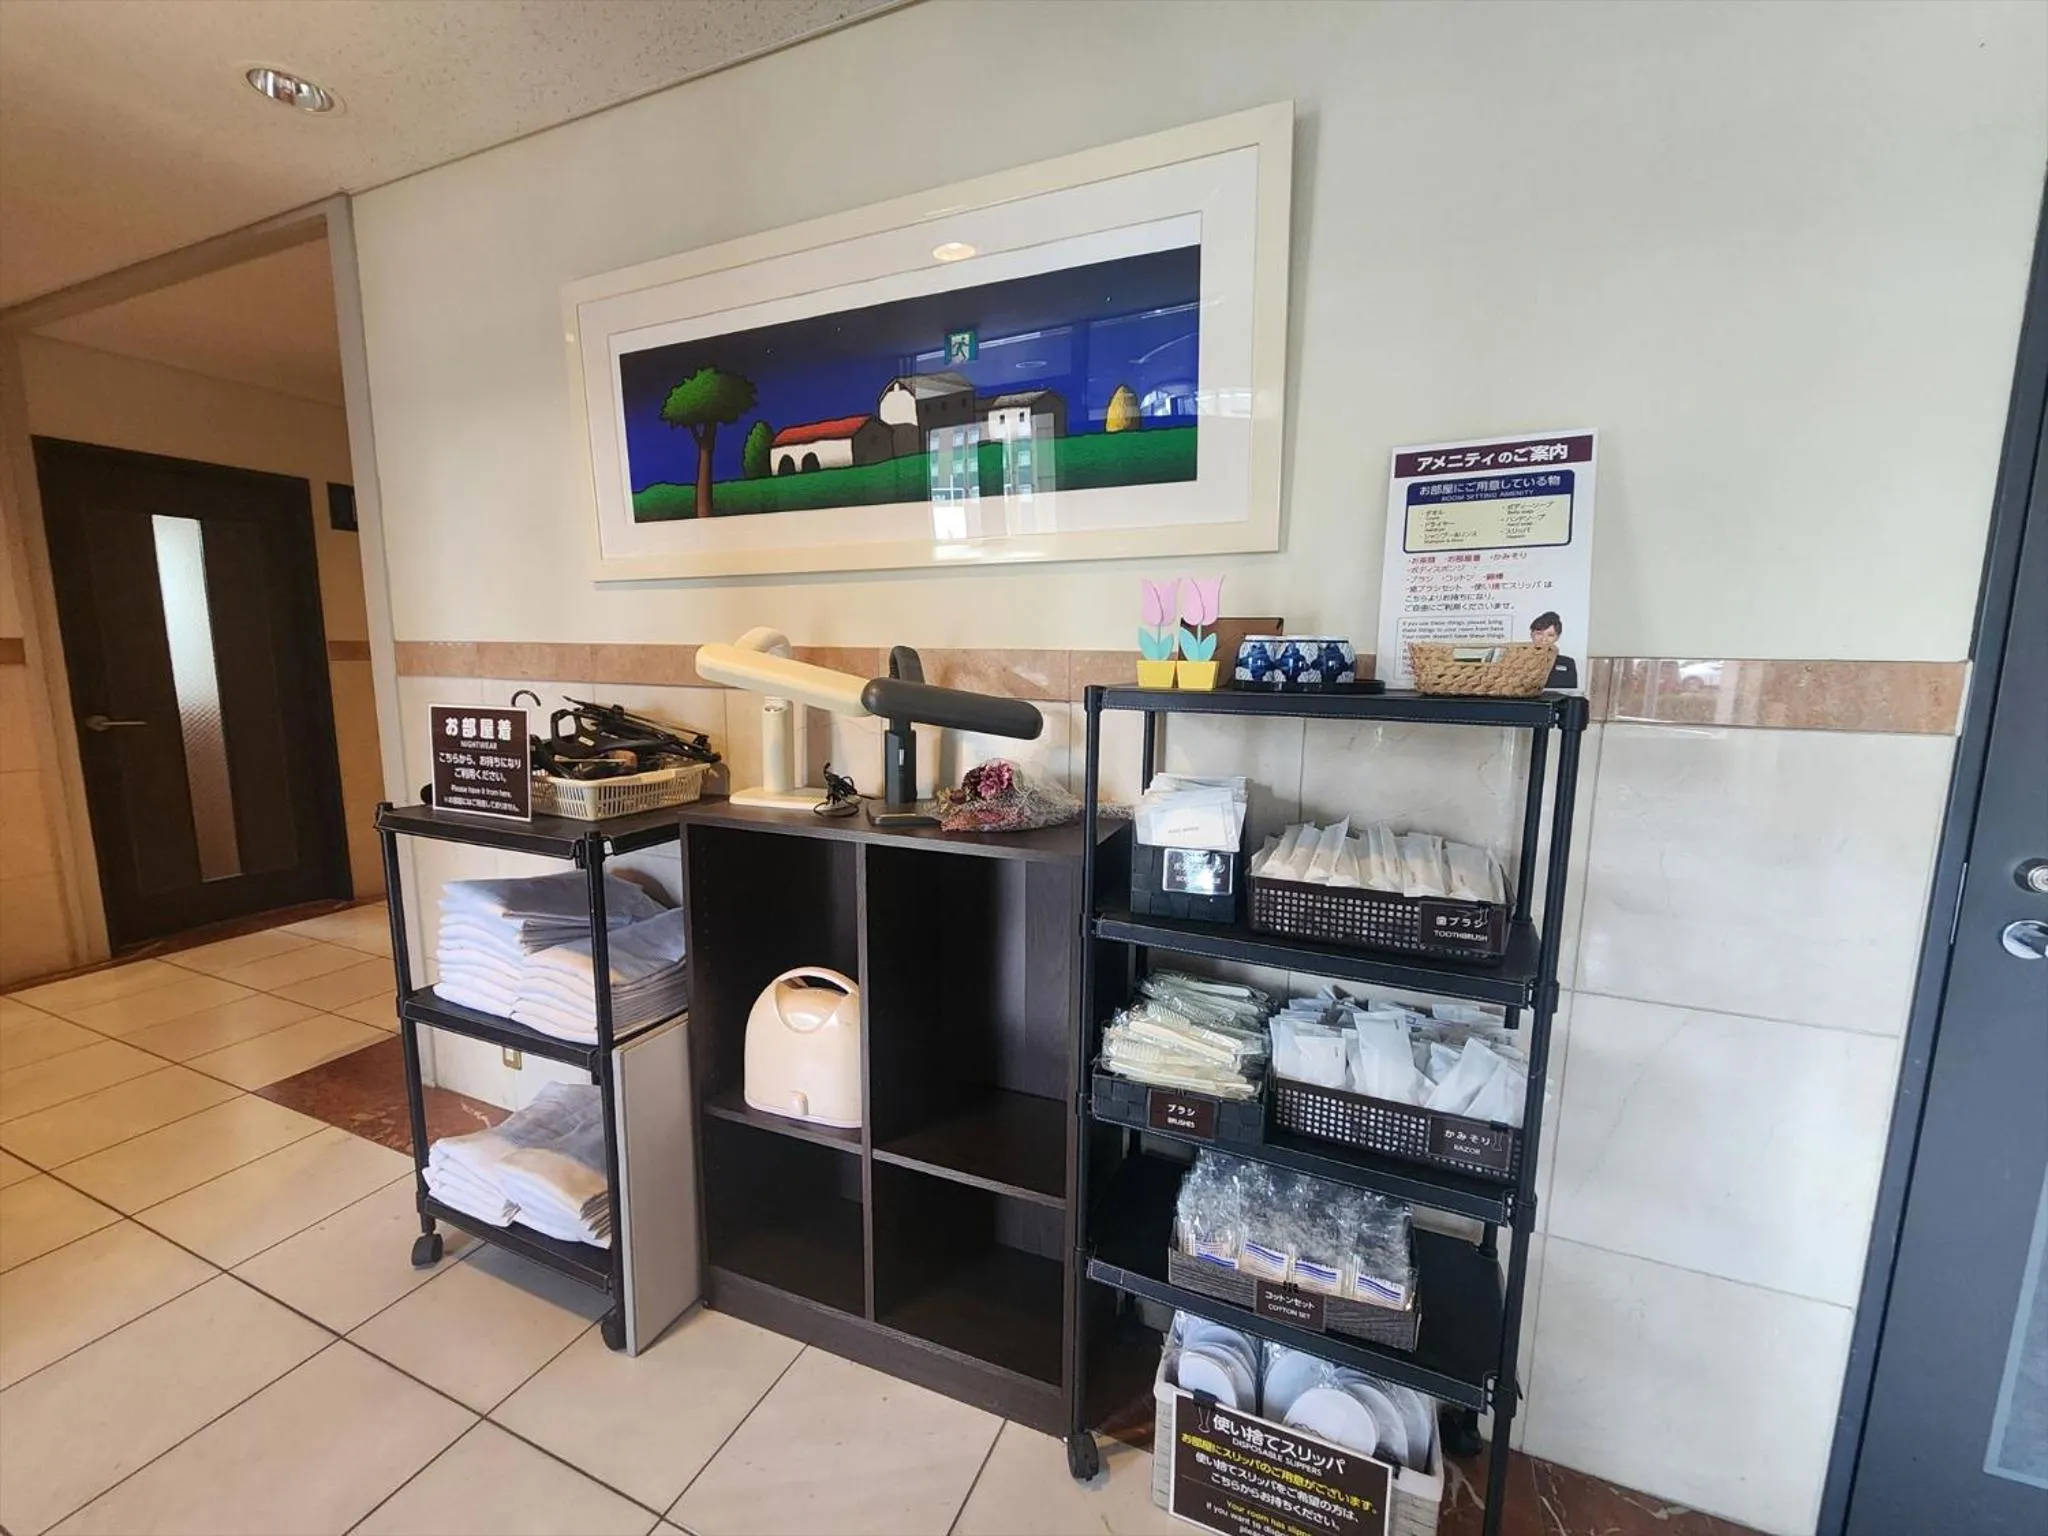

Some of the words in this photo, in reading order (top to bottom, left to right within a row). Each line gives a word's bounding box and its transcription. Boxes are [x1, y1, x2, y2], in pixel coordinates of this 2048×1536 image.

[1417, 443, 1569, 472] アメニティのご案内
[1419, 475, 1561, 497] お部屋にご用意している物
[445, 717, 512, 741] お部屋着
[1435, 915, 1484, 929] 歯ブラシ
[1433, 929, 1488, 942] TOOTHBRUSH
[1167, 1103, 1196, 1117] ブラシ
[1444, 1129, 1491, 1146] かみそり
[1453, 1143, 1481, 1155] RAZOR
[1264, 1290, 1316, 1310] コットンセット
[1267, 1303, 1298, 1317] COTTON
[1213, 1413, 1346, 1475] 使い捨てスリッパ
[1232, 1436, 1284, 1464] DISPOSABLE
[1285, 1456, 1323, 1477] SLIPPERS
[1180, 1432, 1378, 1515] お部屋にスリッパのご用意がございます。
[1195, 1450, 1359, 1523] 使い捨てスリッパをご希望の方は、
[1210, 1472, 1341, 1532] こちらからお持ちください。
[1213, 1505, 1229, 1517] you
[1230, 1511, 1250, 1525] want
[1251, 1519, 1262, 1530] to
[1226, 1500, 1245, 1514] Your
[1247, 1509, 1270, 1523] room
[1270, 1517, 1286, 1530] has
